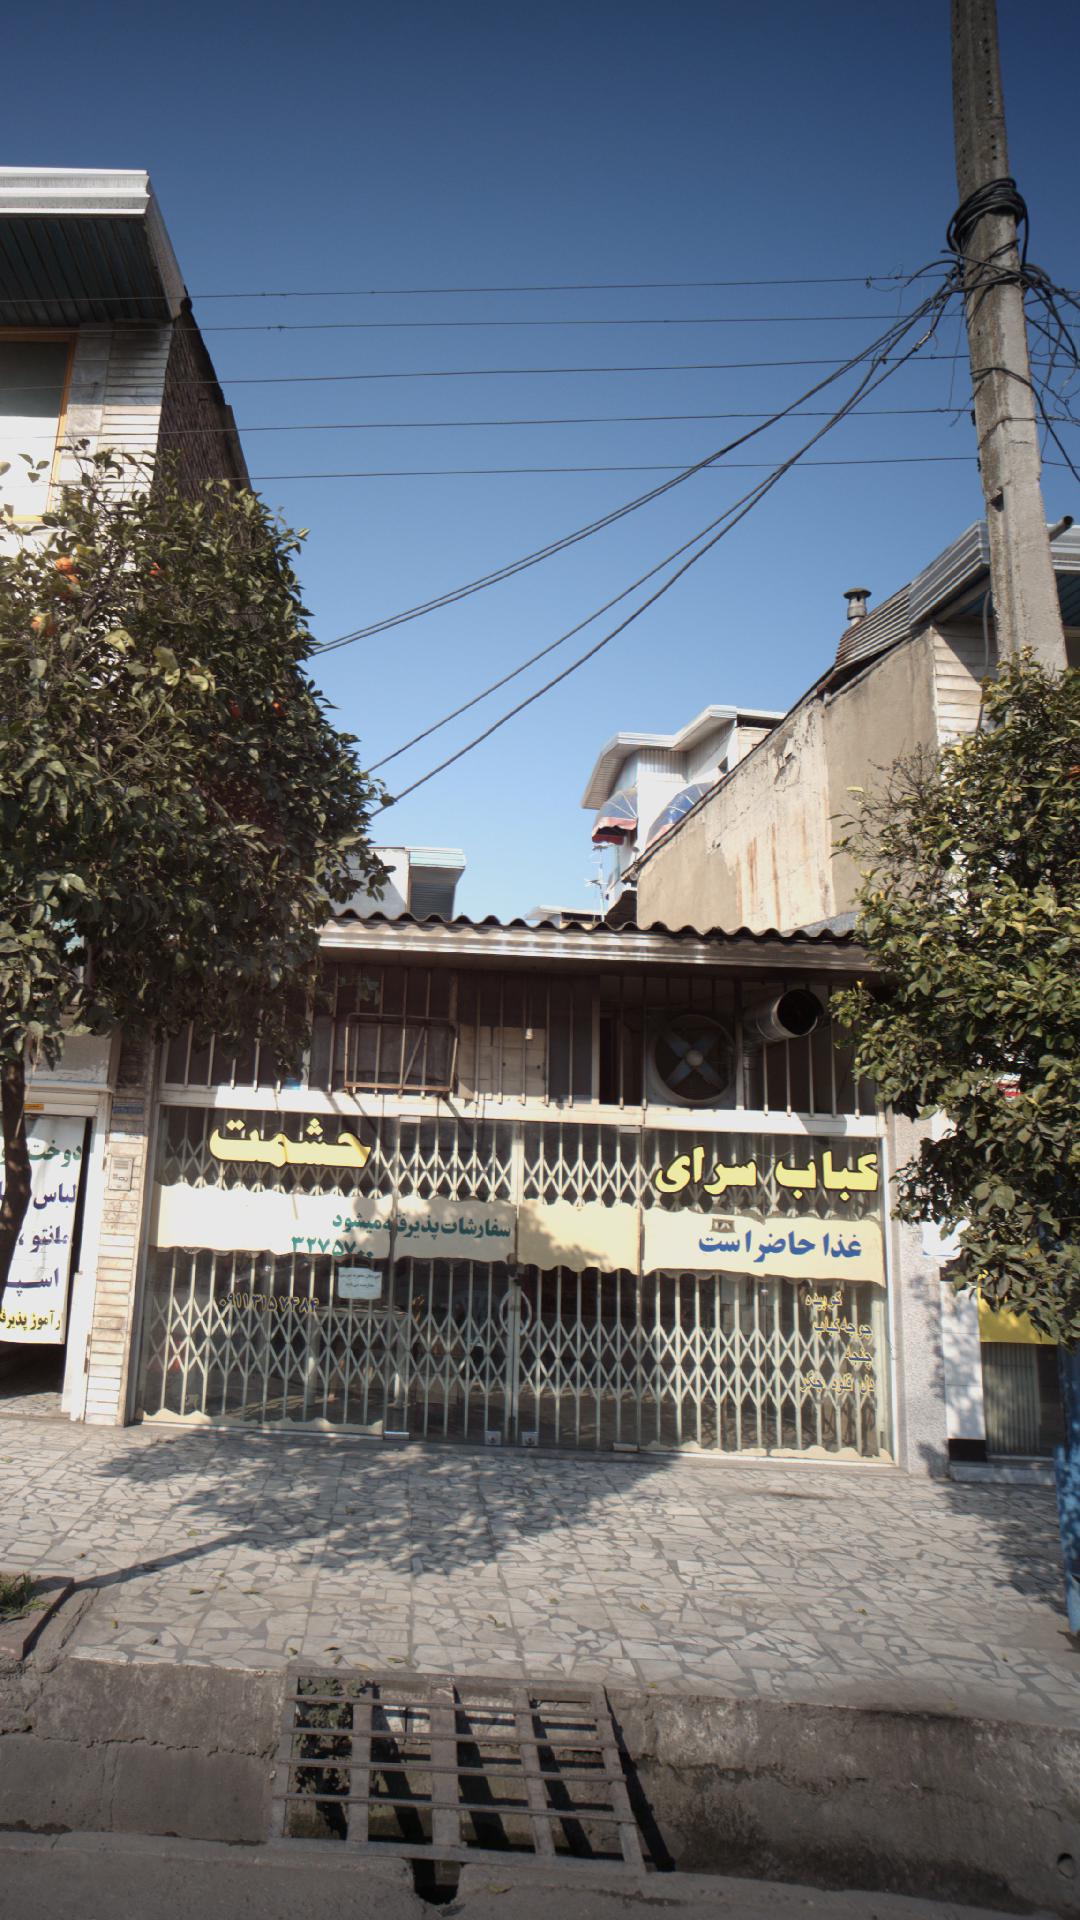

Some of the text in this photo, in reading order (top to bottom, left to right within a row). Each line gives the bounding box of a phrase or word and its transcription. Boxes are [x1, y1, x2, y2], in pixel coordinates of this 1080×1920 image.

[209, 1118, 372, 1168] حشمت
[654, 1145, 879, 1202] کباب سرای
[33, 1182, 76, 1210] لباس
[441, 1215, 511, 1239] سفارشات
[698, 1230, 862, 1263] غذا حاضر است
